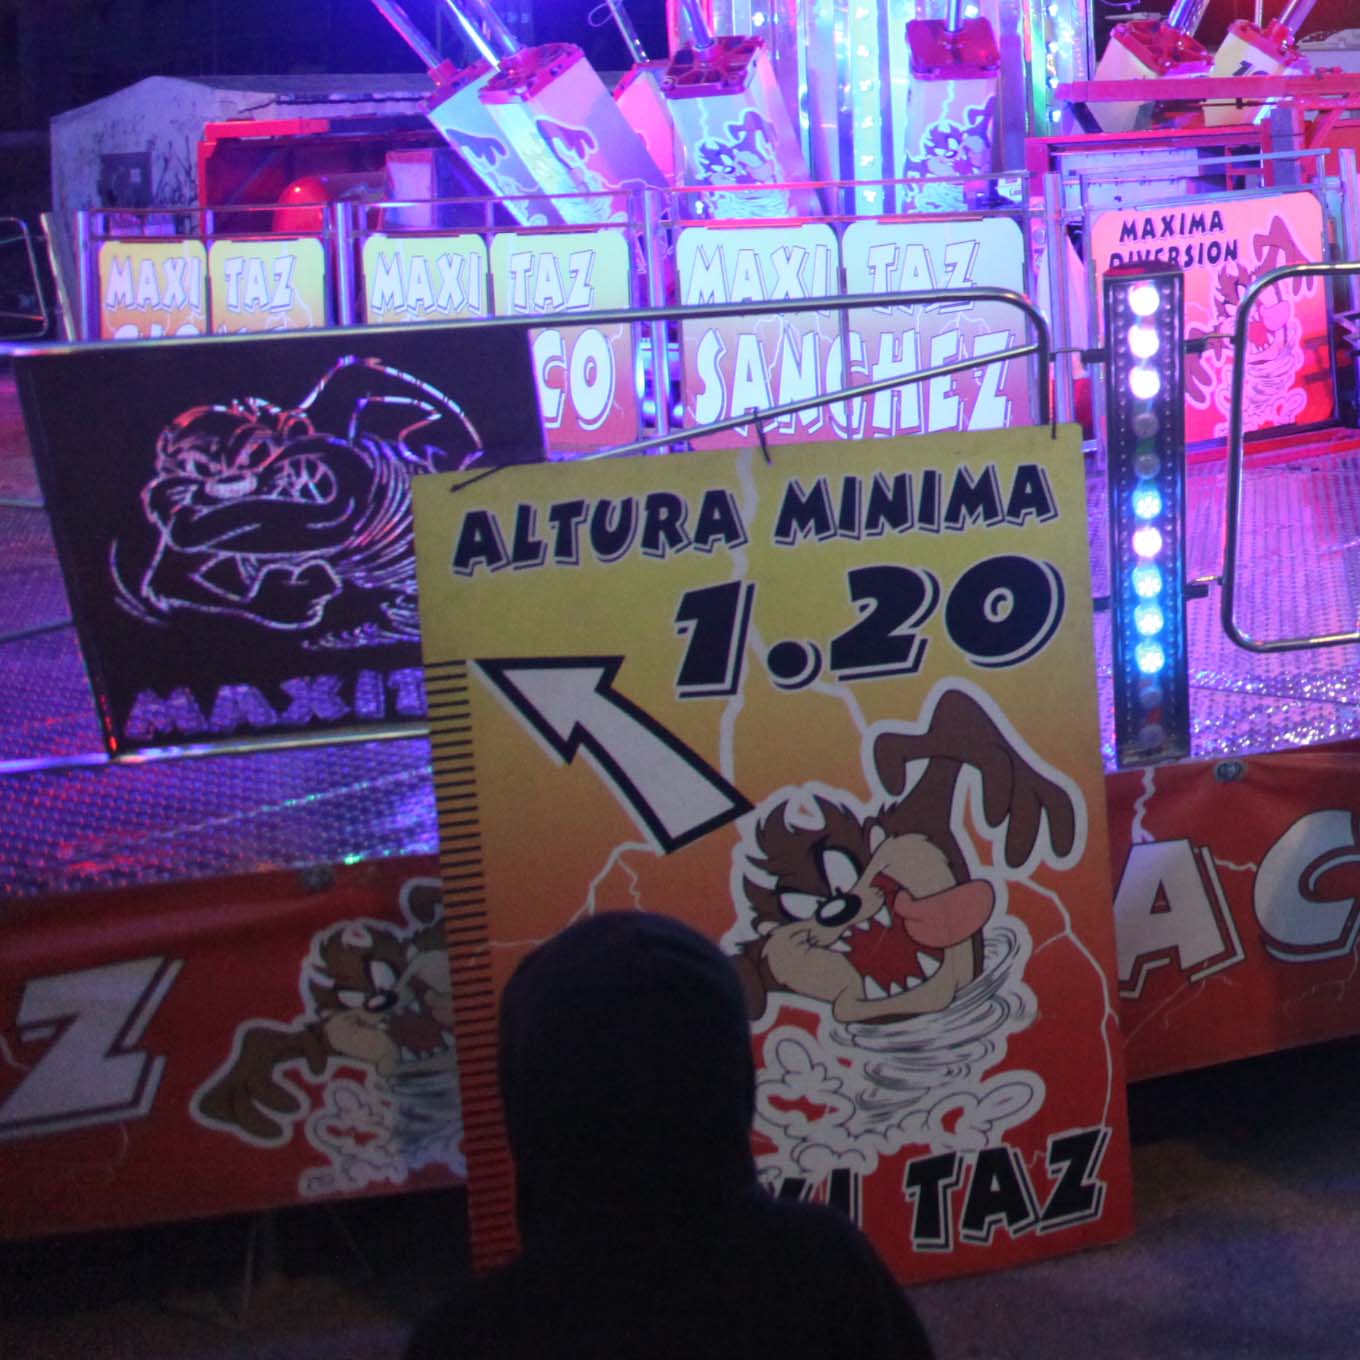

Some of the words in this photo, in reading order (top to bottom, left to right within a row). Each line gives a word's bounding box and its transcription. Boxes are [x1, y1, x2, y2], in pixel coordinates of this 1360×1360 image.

[1119, 210, 1223, 242] MAXIMA
[105, 254, 201, 313] MAXI
[224, 251, 297, 312] TAZ
[370, 249, 482, 314] MAXI
[508, 248, 597, 315] TAZ
[687, 243, 832, 320] MAXI
[868, 240, 979, 314] TAZ
[695, 328, 1015, 440] SANCHEZ
[453, 489, 748, 577] ALTURA
[773, 464, 1059, 546] MINIMA
[675, 556, 1065, 699] 1.20
[905, 1126, 1111, 1251] TAZ
